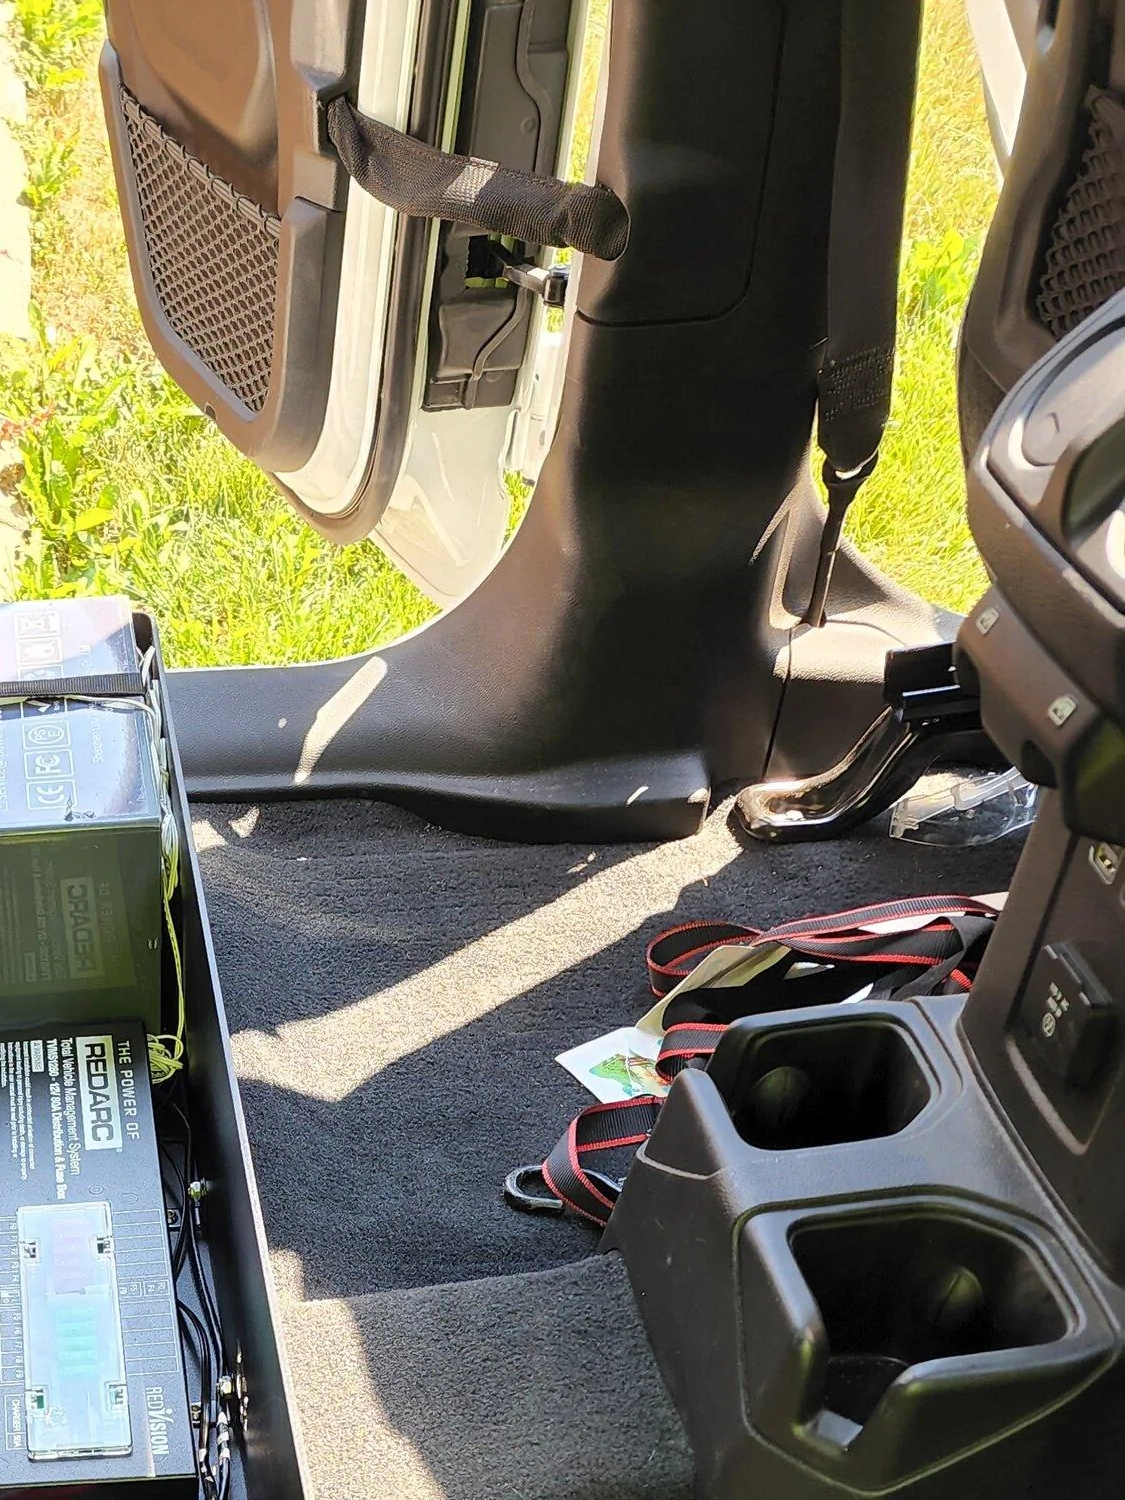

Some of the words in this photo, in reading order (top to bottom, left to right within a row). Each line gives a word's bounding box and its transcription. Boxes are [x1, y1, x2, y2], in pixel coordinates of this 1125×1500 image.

[46, 1038, 59, 1077] TVMS1280
[60, 1038, 74, 1057] Total
[117, 1041, 131, 1064] THE
[62, 1058, 76, 1086] Vehicle
[49, 1082, 60, 1096] 12V
[85, 1043, 114, 1142] REDARC
[120, 1070, 137, 1116] POWER
[63, 1088, 78, 1141] Management
[52, 1113, 64, 1155] Distribution
[126, 1123, 139, 1140] OF
[66, 1143, 81, 1175] System
[55, 1164, 66, 1183] Fuse
[56, 1184, 67, 1200] Box
